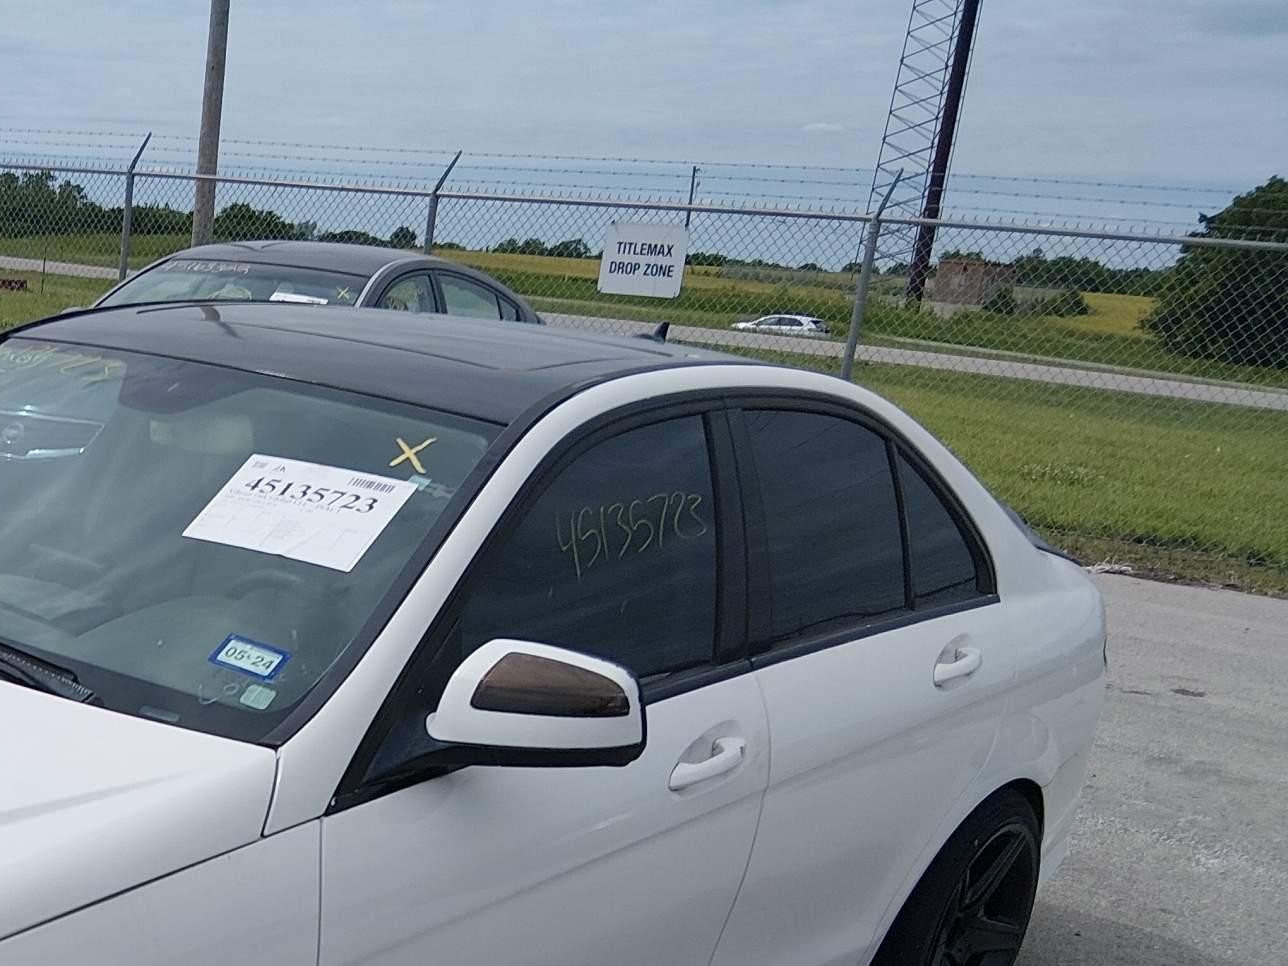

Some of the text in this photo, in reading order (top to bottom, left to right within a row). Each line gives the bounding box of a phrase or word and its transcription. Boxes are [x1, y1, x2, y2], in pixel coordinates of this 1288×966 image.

[616, 241, 675, 258] TITLEMAX
[608, 260, 675, 278] DROP ZONE
[244, 476, 379, 514] 45135723
[554, 490, 708, 583] 45135723
